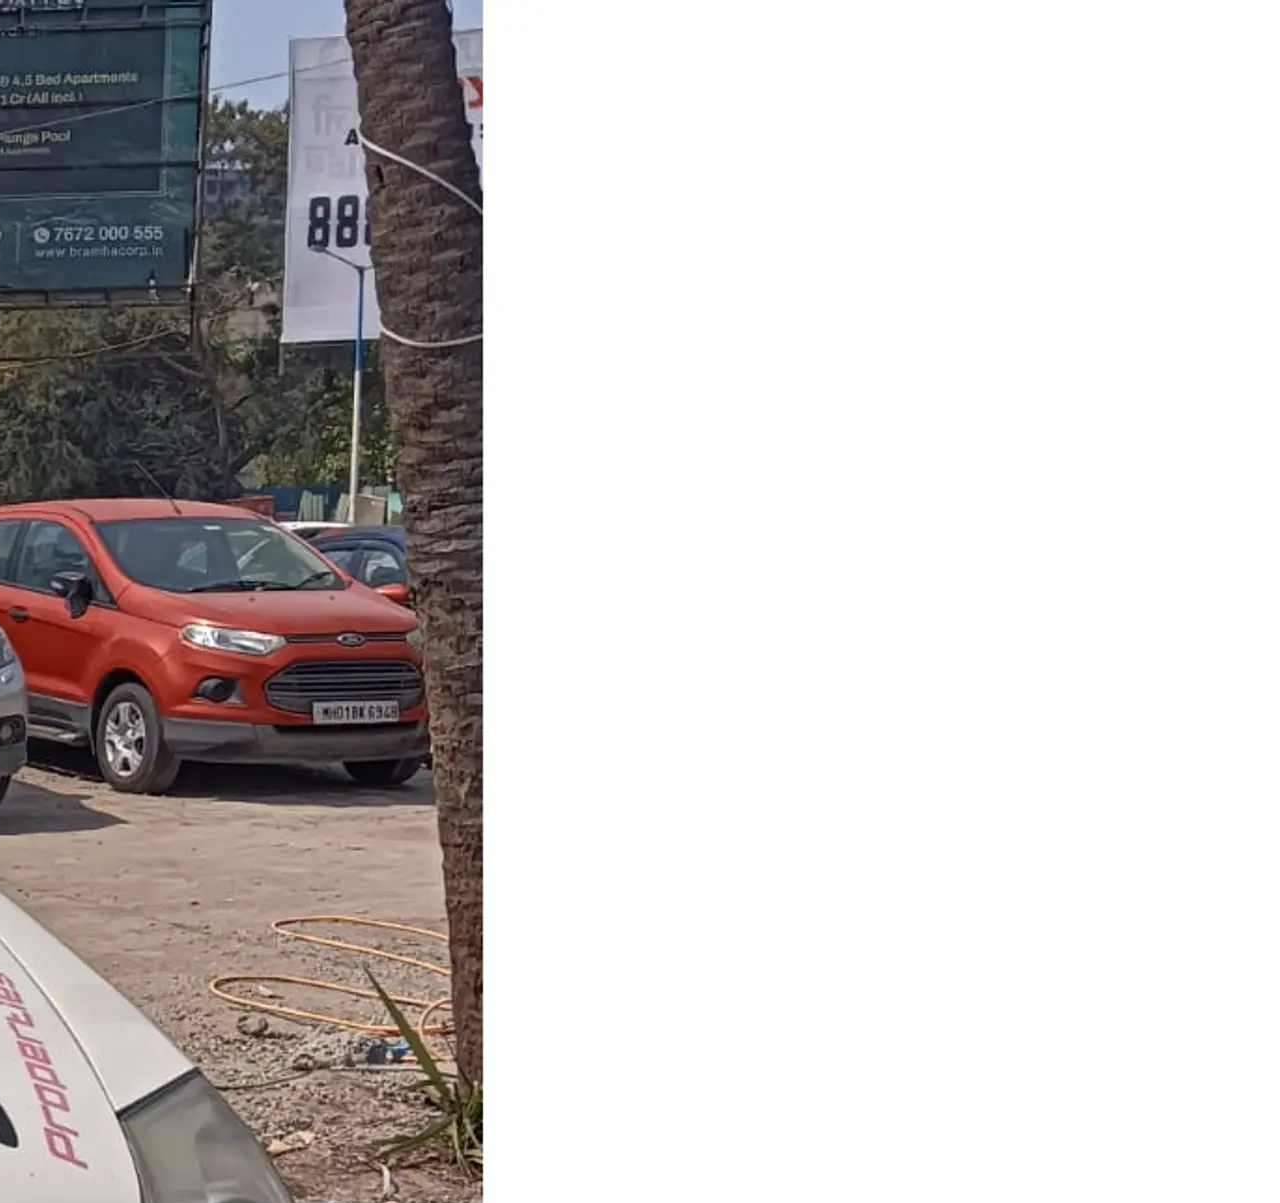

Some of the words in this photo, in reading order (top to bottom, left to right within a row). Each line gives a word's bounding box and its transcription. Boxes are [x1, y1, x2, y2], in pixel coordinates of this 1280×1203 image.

[35, 73, 60, 86] Bed
[63, 72, 138, 85] Apartments
[42, 130, 71, 142] Pool
[308, 196, 371, 247] 88
[53, 226, 95, 241] 7672
[99, 226, 129, 240] 000
[133, 226, 163, 240] 555
